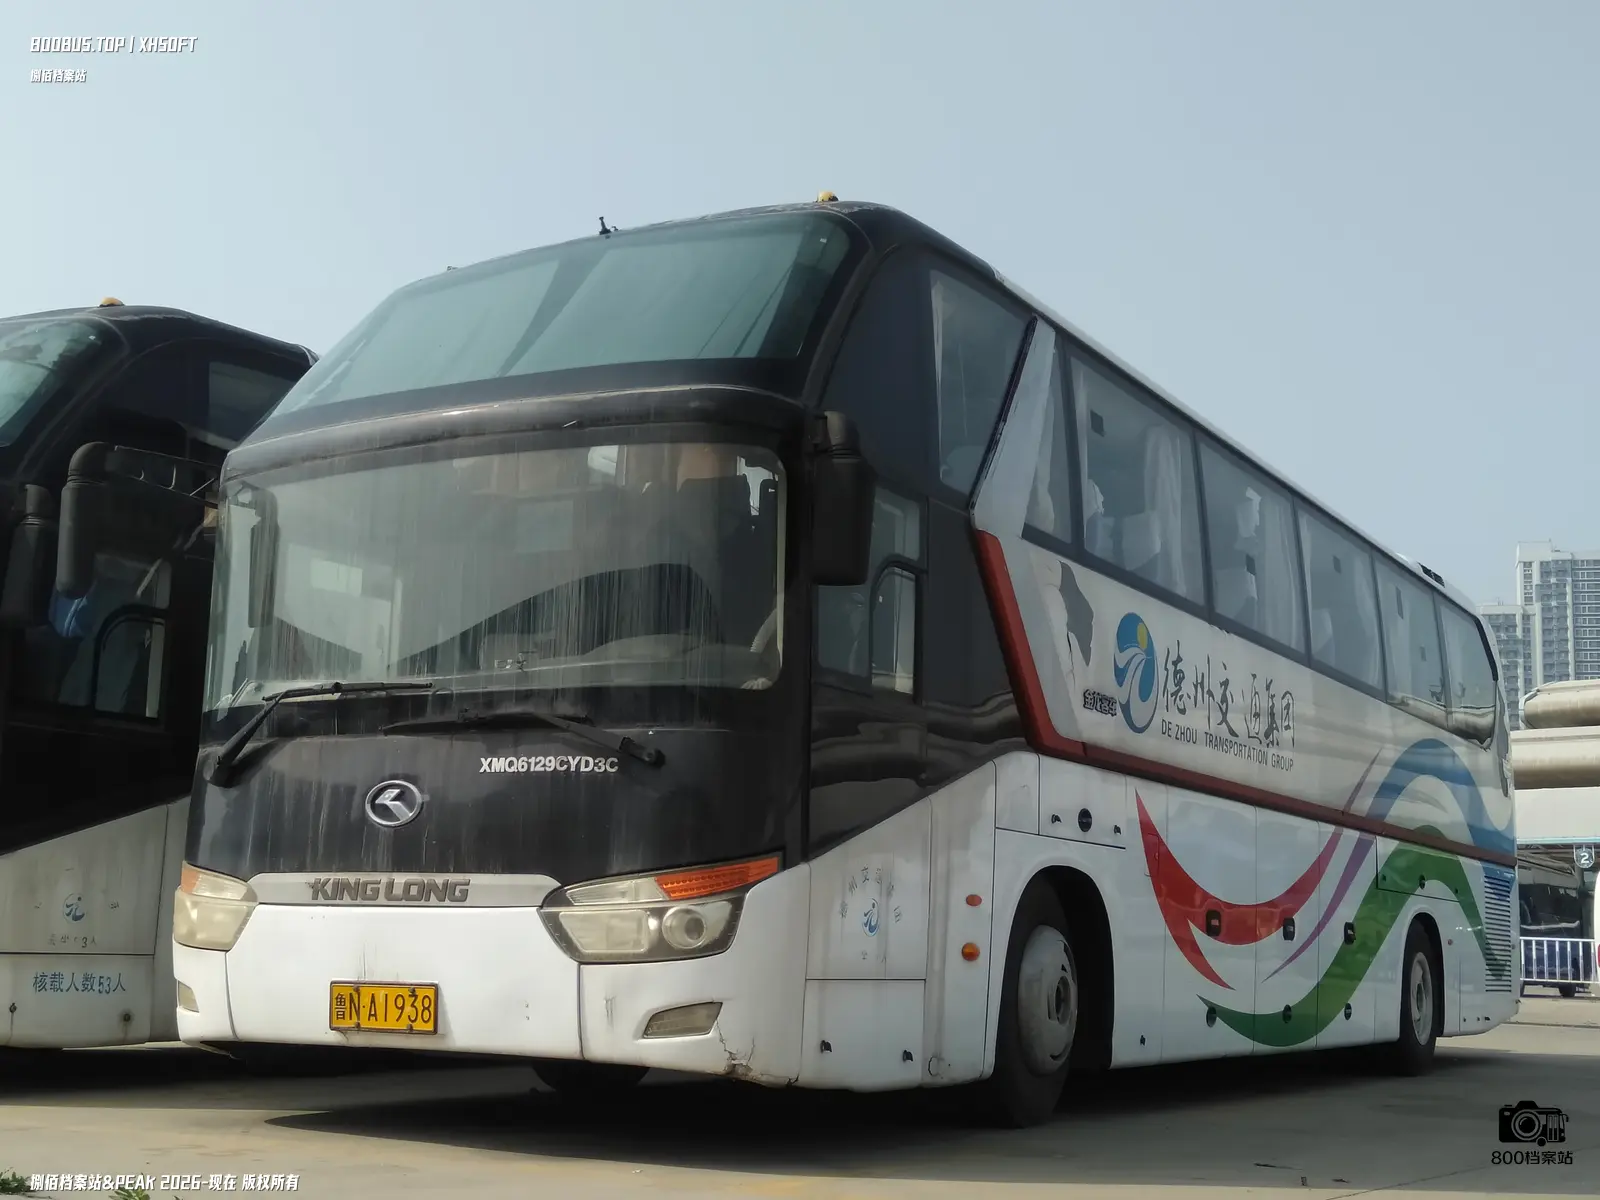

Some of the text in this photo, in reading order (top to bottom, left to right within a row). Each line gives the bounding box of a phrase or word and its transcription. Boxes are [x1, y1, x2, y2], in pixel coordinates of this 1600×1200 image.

[1162, 640, 1295, 748] 德州交通集团
[1161, 719, 1294, 772] DE ZHOU TRANSPORTATION GROUP
[479, 756, 619, 773] XMQ6129CYD3C
[1580, 852, 1590, 864] 2
[311, 878, 470, 902] KING LONG
[32, 971, 126, 995] 核载人数53人
